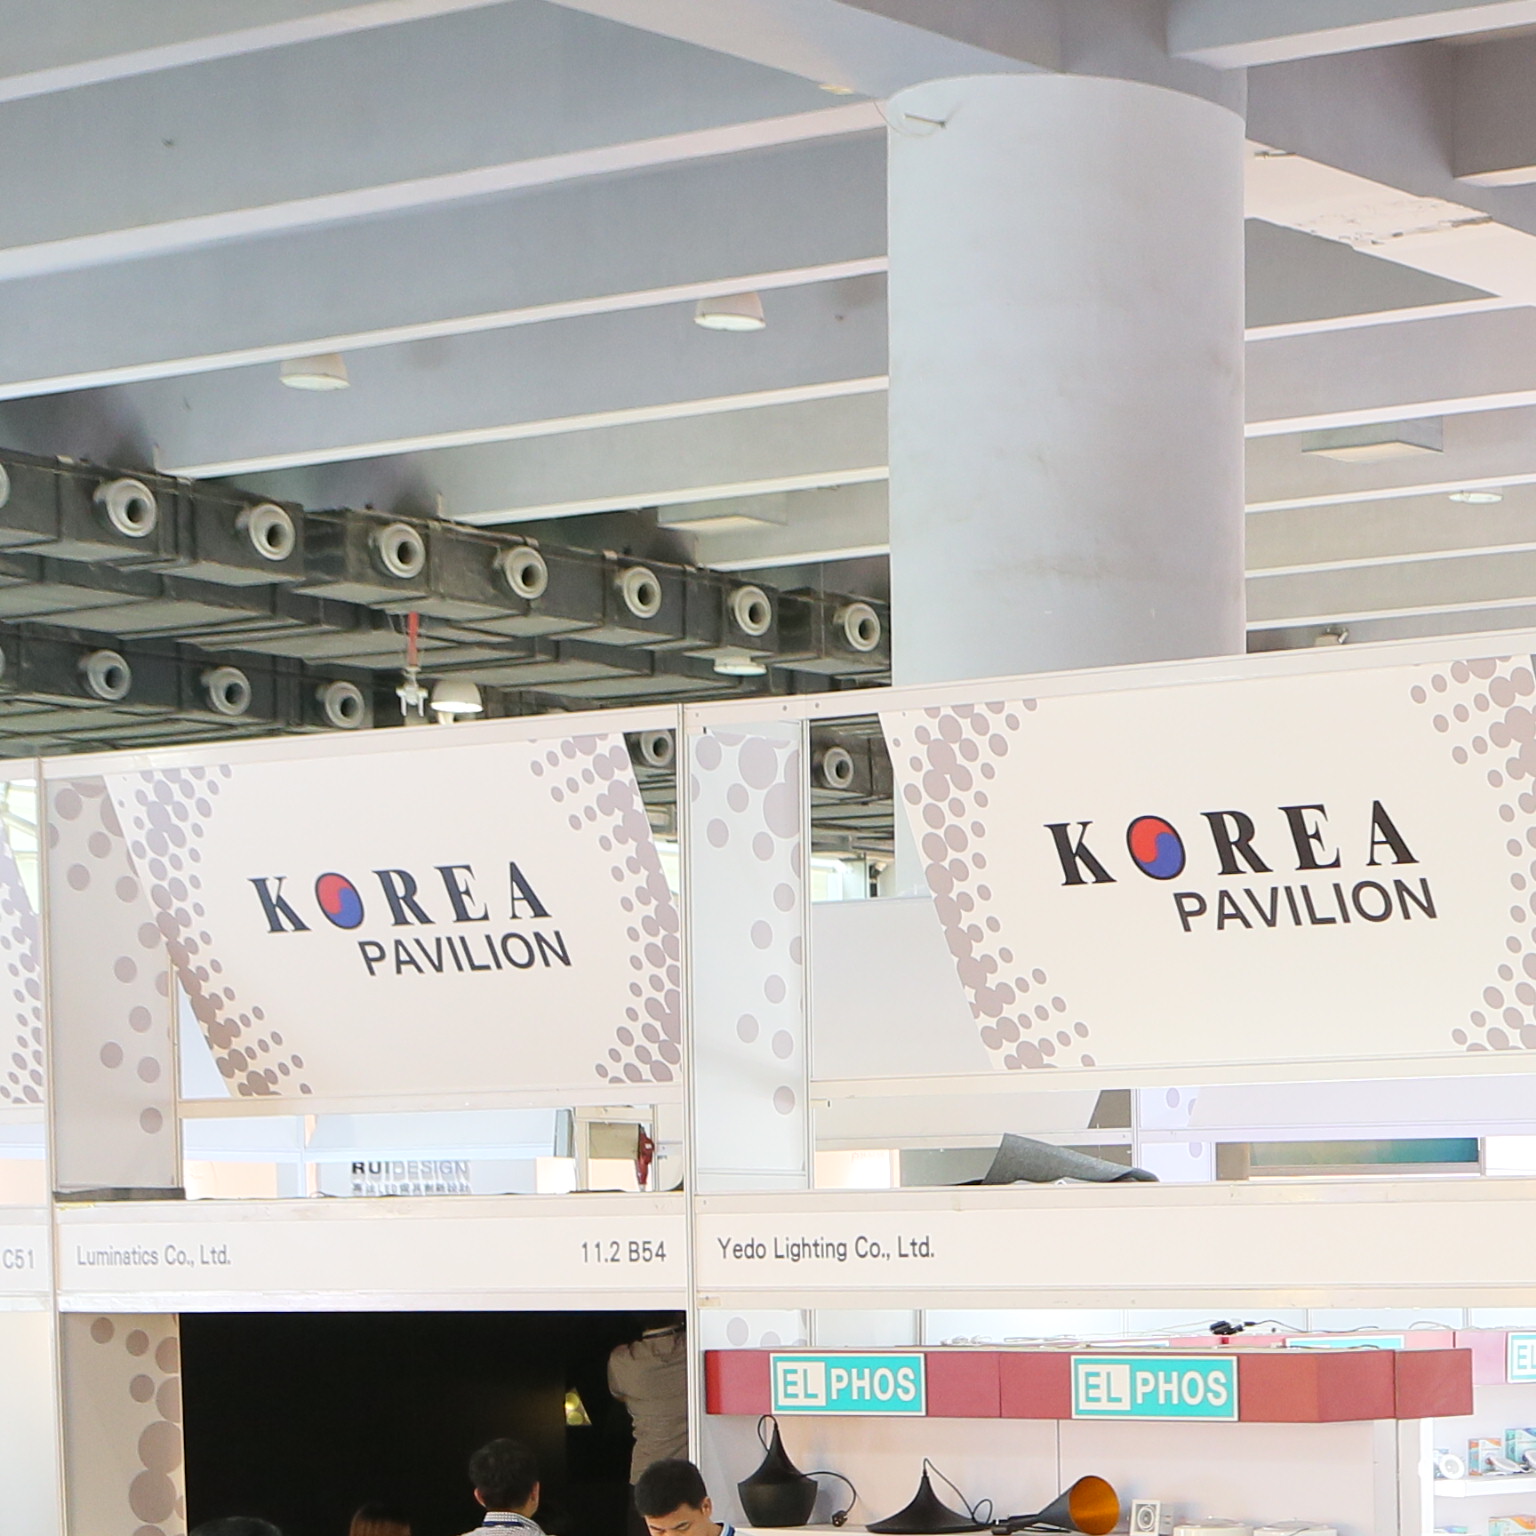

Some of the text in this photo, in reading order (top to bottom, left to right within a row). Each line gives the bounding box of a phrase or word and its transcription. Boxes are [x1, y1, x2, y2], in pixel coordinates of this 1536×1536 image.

[1044, 799, 1420, 887] KOREA
[247, 860, 552, 934] KOREA
[1173, 877, 1438, 932] PAVILION
[357, 930, 572, 977] PAVILION
[3, 1249, 35, 1269] C51
[76, 1243, 231, 1269] Luminatics Co., Ltd.
[582, 1240, 667, 1262] 11.2 B54
[718, 1235, 934, 1262] Yedo Lighting Co., Ltd.
